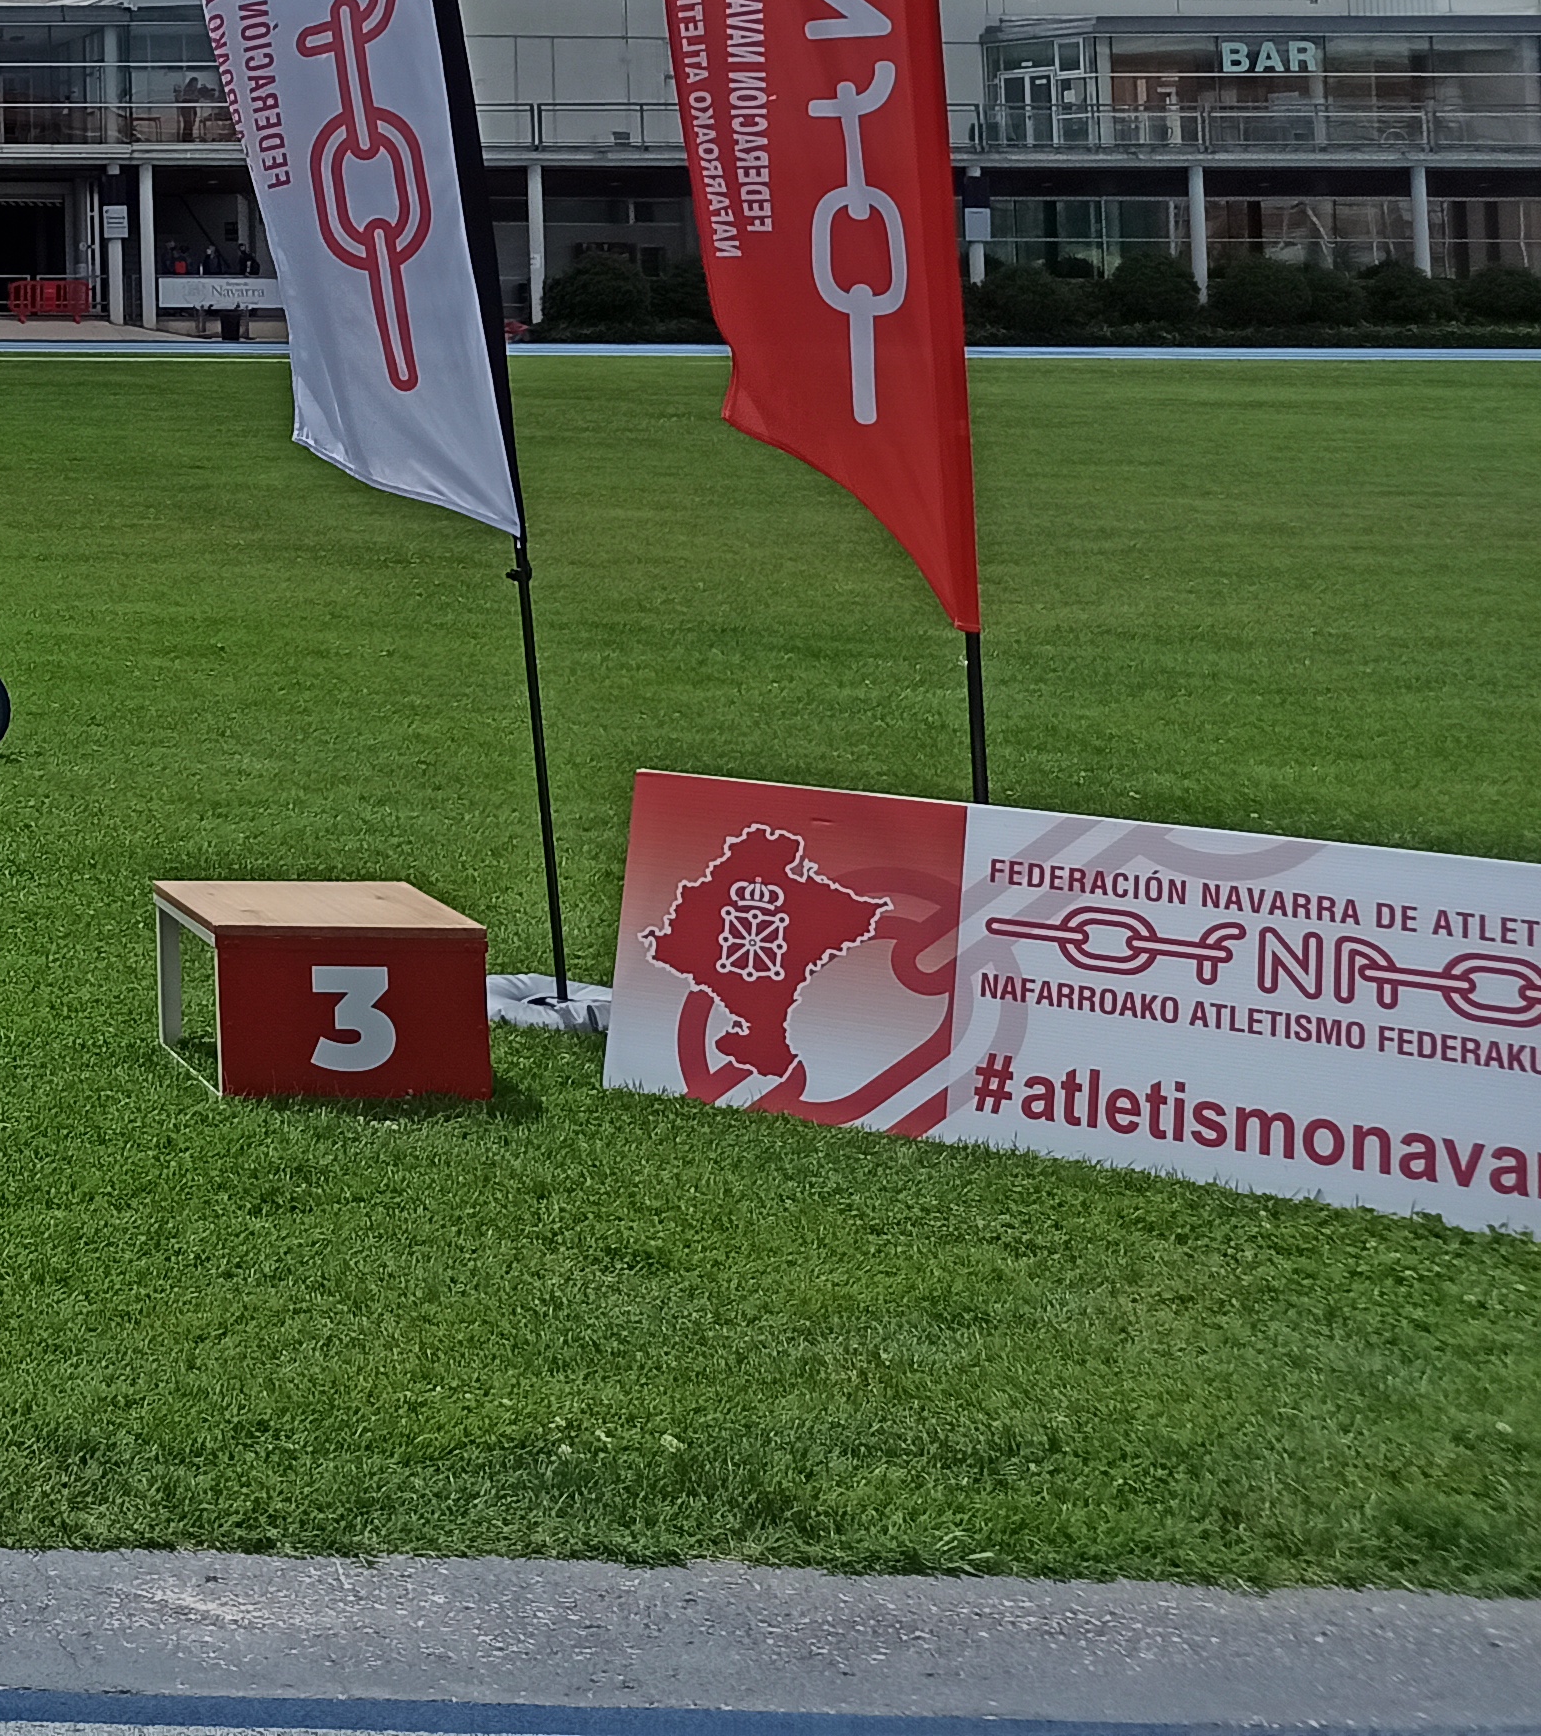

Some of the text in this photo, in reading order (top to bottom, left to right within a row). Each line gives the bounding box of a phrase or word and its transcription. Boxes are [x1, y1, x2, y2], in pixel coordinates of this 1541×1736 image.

[1221, 41, 1317, 73] BAR
[211, 284, 265, 298] Navarra
[989, 859, 1187, 906] FEDERACIÓN
[1200, 883, 1360, 926] NAVARRA
[1376, 902, 1418, 933] DE
[310, 965, 397, 1072] 3
[979, 971, 1178, 1025] NAFARROAKO
[1189, 999, 1366, 1050] ATLETISMO
[974, 1051, 1541, 1198] #atletismonava
